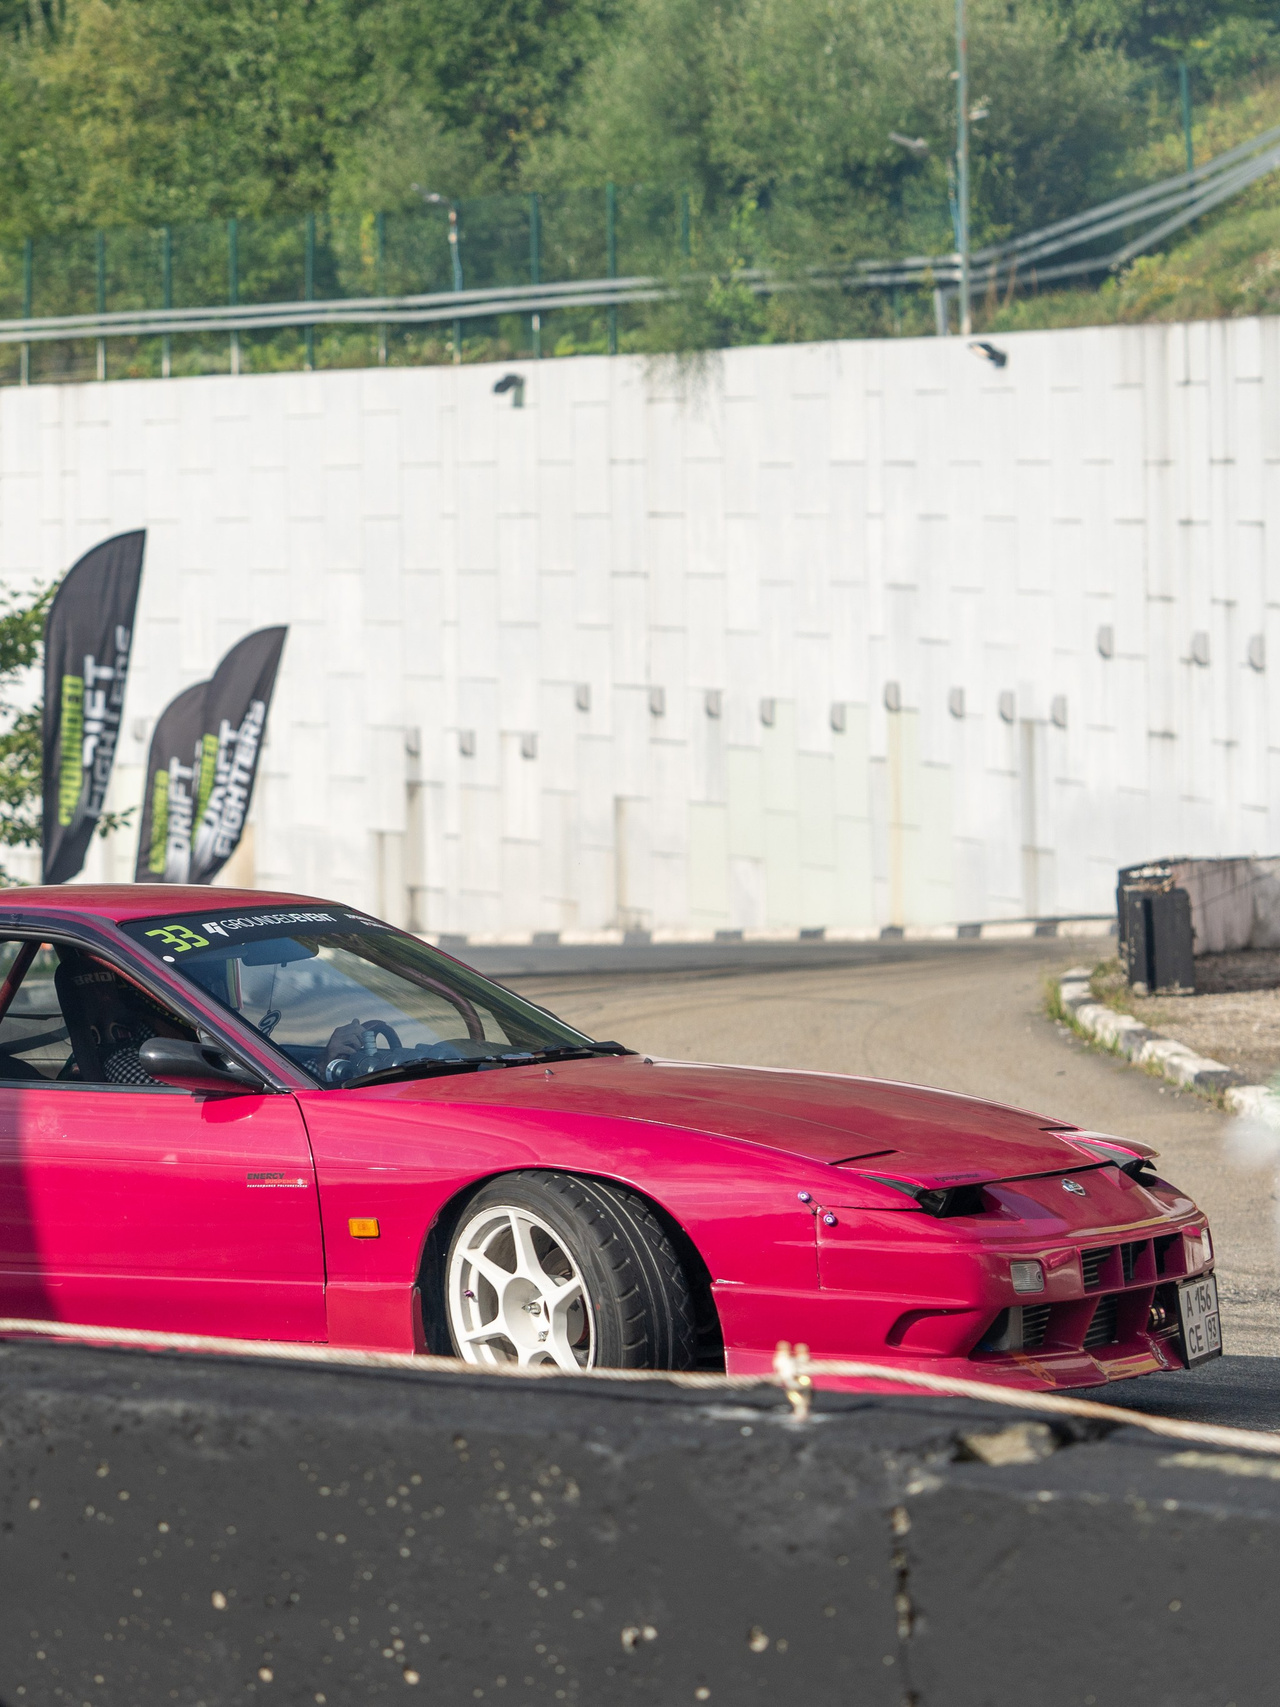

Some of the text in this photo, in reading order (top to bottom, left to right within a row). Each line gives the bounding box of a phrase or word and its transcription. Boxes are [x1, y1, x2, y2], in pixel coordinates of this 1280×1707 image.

[166, 756, 194, 862] DRIFT
[145, 924, 210, 952] 33
[1188, 1324, 1204, 1354] CE
[1207, 1316, 1217, 1339] 93
